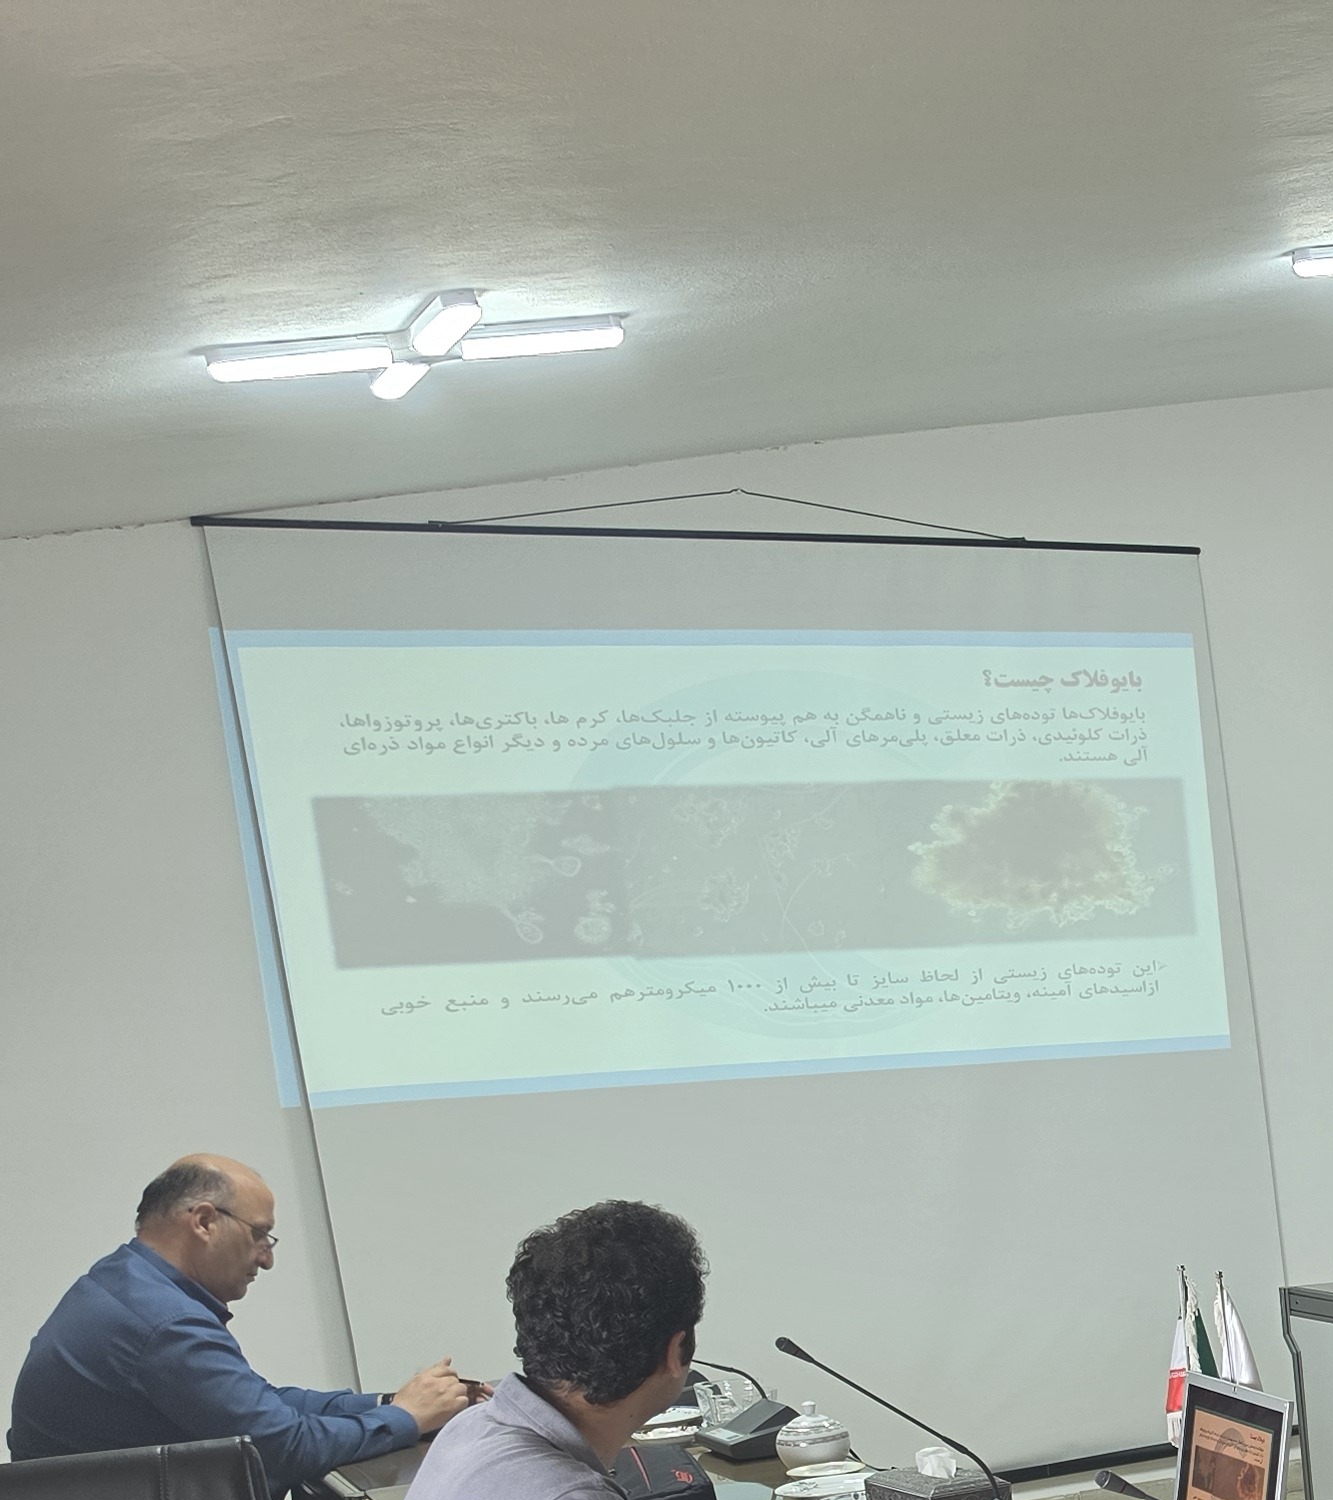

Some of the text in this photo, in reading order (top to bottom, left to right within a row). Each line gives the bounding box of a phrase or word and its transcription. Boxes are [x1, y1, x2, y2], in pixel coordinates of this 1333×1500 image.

[982, 669, 1142, 693] بایوفلاک چیست؟
[576, 709, 609, 729] کرم
[704, 709, 718, 727] از
[724, 710, 785, 727] پیوسته
[792, 711, 817, 726] هم
[823, 712, 839, 726] به
[846, 707, 906, 726] ناهمگن
[913, 713, 921, 725] و
[928, 709, 984, 725] زیستی
[407, 735, 446, 755] مواد
[453, 734, 494, 754] انواع
[501, 733, 545, 753] دیگر
[552, 738, 561, 752] و
[567, 736, 609, 752] مرده
[707, 736, 717, 749] و
[986, 729, 1026, 747] ذرات
[1108, 727, 1148, 746] ذرات
[1123, 746, 1148, 766] آلی
[919, 968, 959, 983] لحاظ
[971, 968, 983, 985] از
[993, 966, 1048, 984] زیستی
[1133, 960, 1157, 977] این
[728, 979, 762, 993] ۱۰۰۰
[775, 977, 788, 994] از
[799, 975, 837, 993] بیش
[847, 973, 860, 987] تا
[872, 971, 909, 990] سایز
[381, 995, 432, 1016] خوبی
[445, 994, 489, 1013] منبع
[500, 996, 510, 1009] و
[843, 996, 895, 1013] معدنی
[900, 992, 933, 1008] مواد
